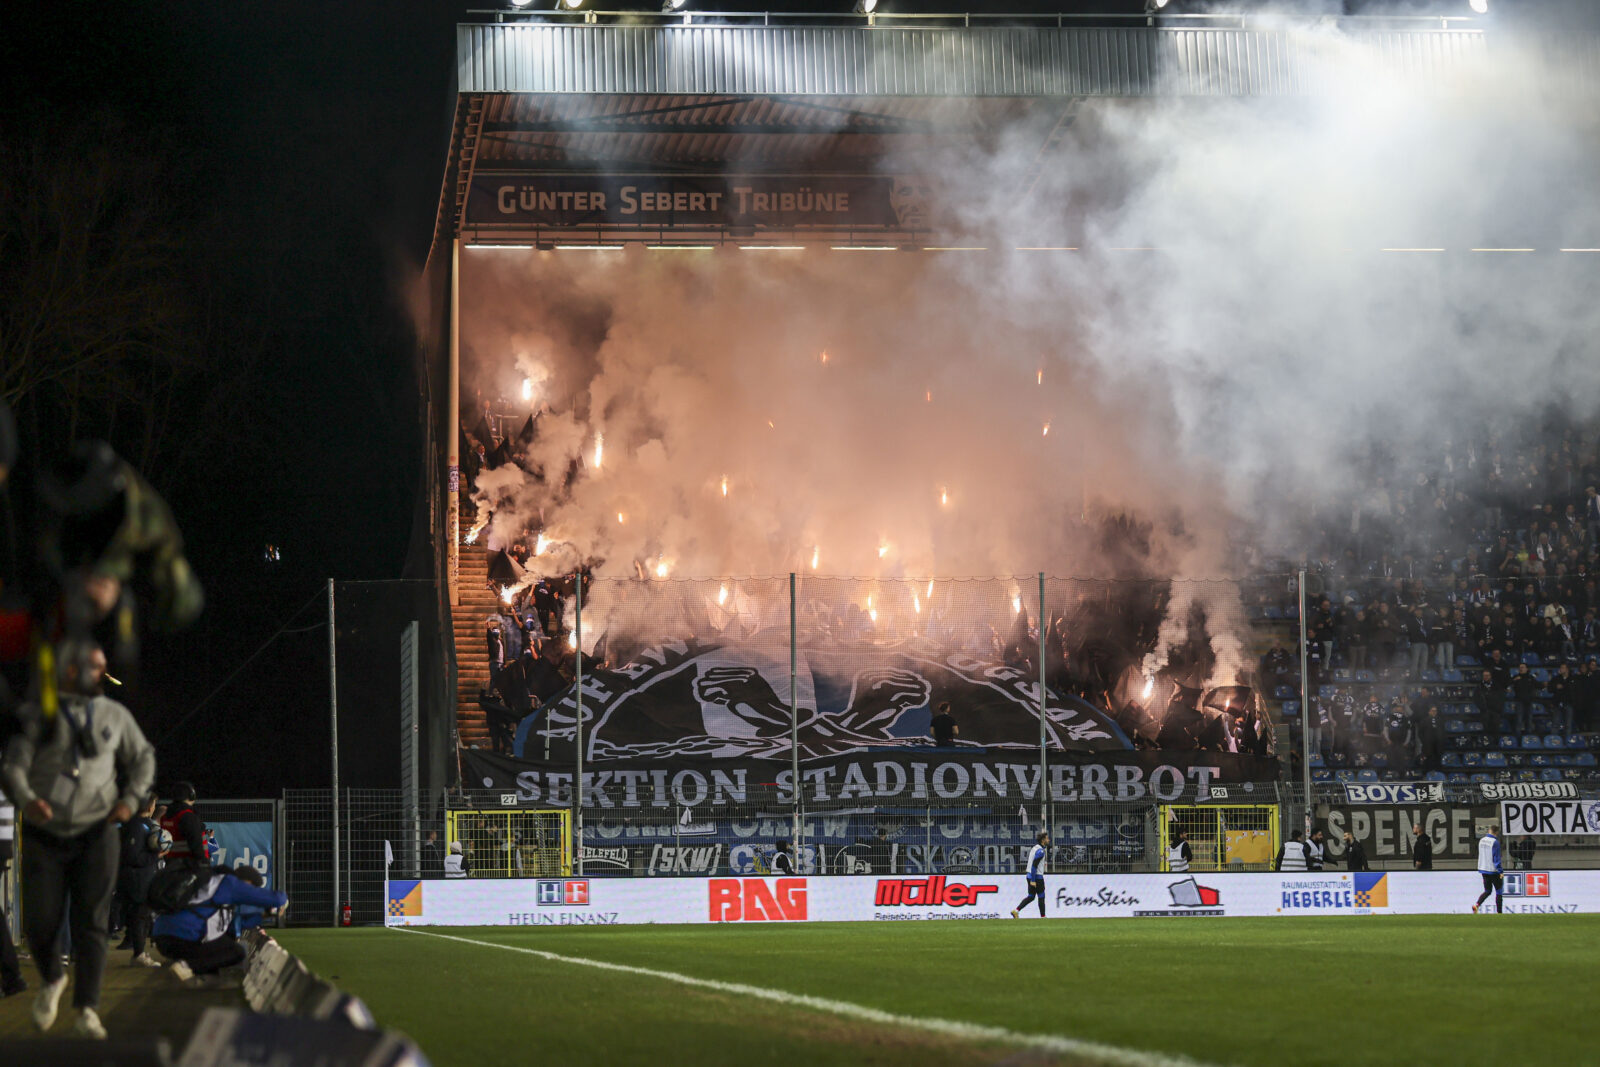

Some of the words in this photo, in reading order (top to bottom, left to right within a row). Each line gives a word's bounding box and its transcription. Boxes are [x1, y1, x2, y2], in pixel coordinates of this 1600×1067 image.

[498, 185, 606, 214] GÜNTER
[620, 186, 722, 214] SEBERT
[734, 186, 849, 214] TRIBÜNE
[515, 768, 747, 808] SEKTION
[775, 760, 1221, 804] STADIONVERBOT
[1213, 788, 1226, 797] 26
[502, 795, 516, 804] 27
[1346, 785, 1417, 803] BOYS
[1504, 802, 1588, 834] PORTA
[1327, 808, 1471, 857] SPENGE
[577, 846, 628, 863] IELEFELD
[1281, 881, 1352, 889] RAUMAUSSTATTUNG
[1056, 886, 1140, 910] FormStein
[1281, 890, 1352, 909] HEBERLE
[509, 913, 554, 925] HEUN
[560, 912, 619, 925] FINANZ
